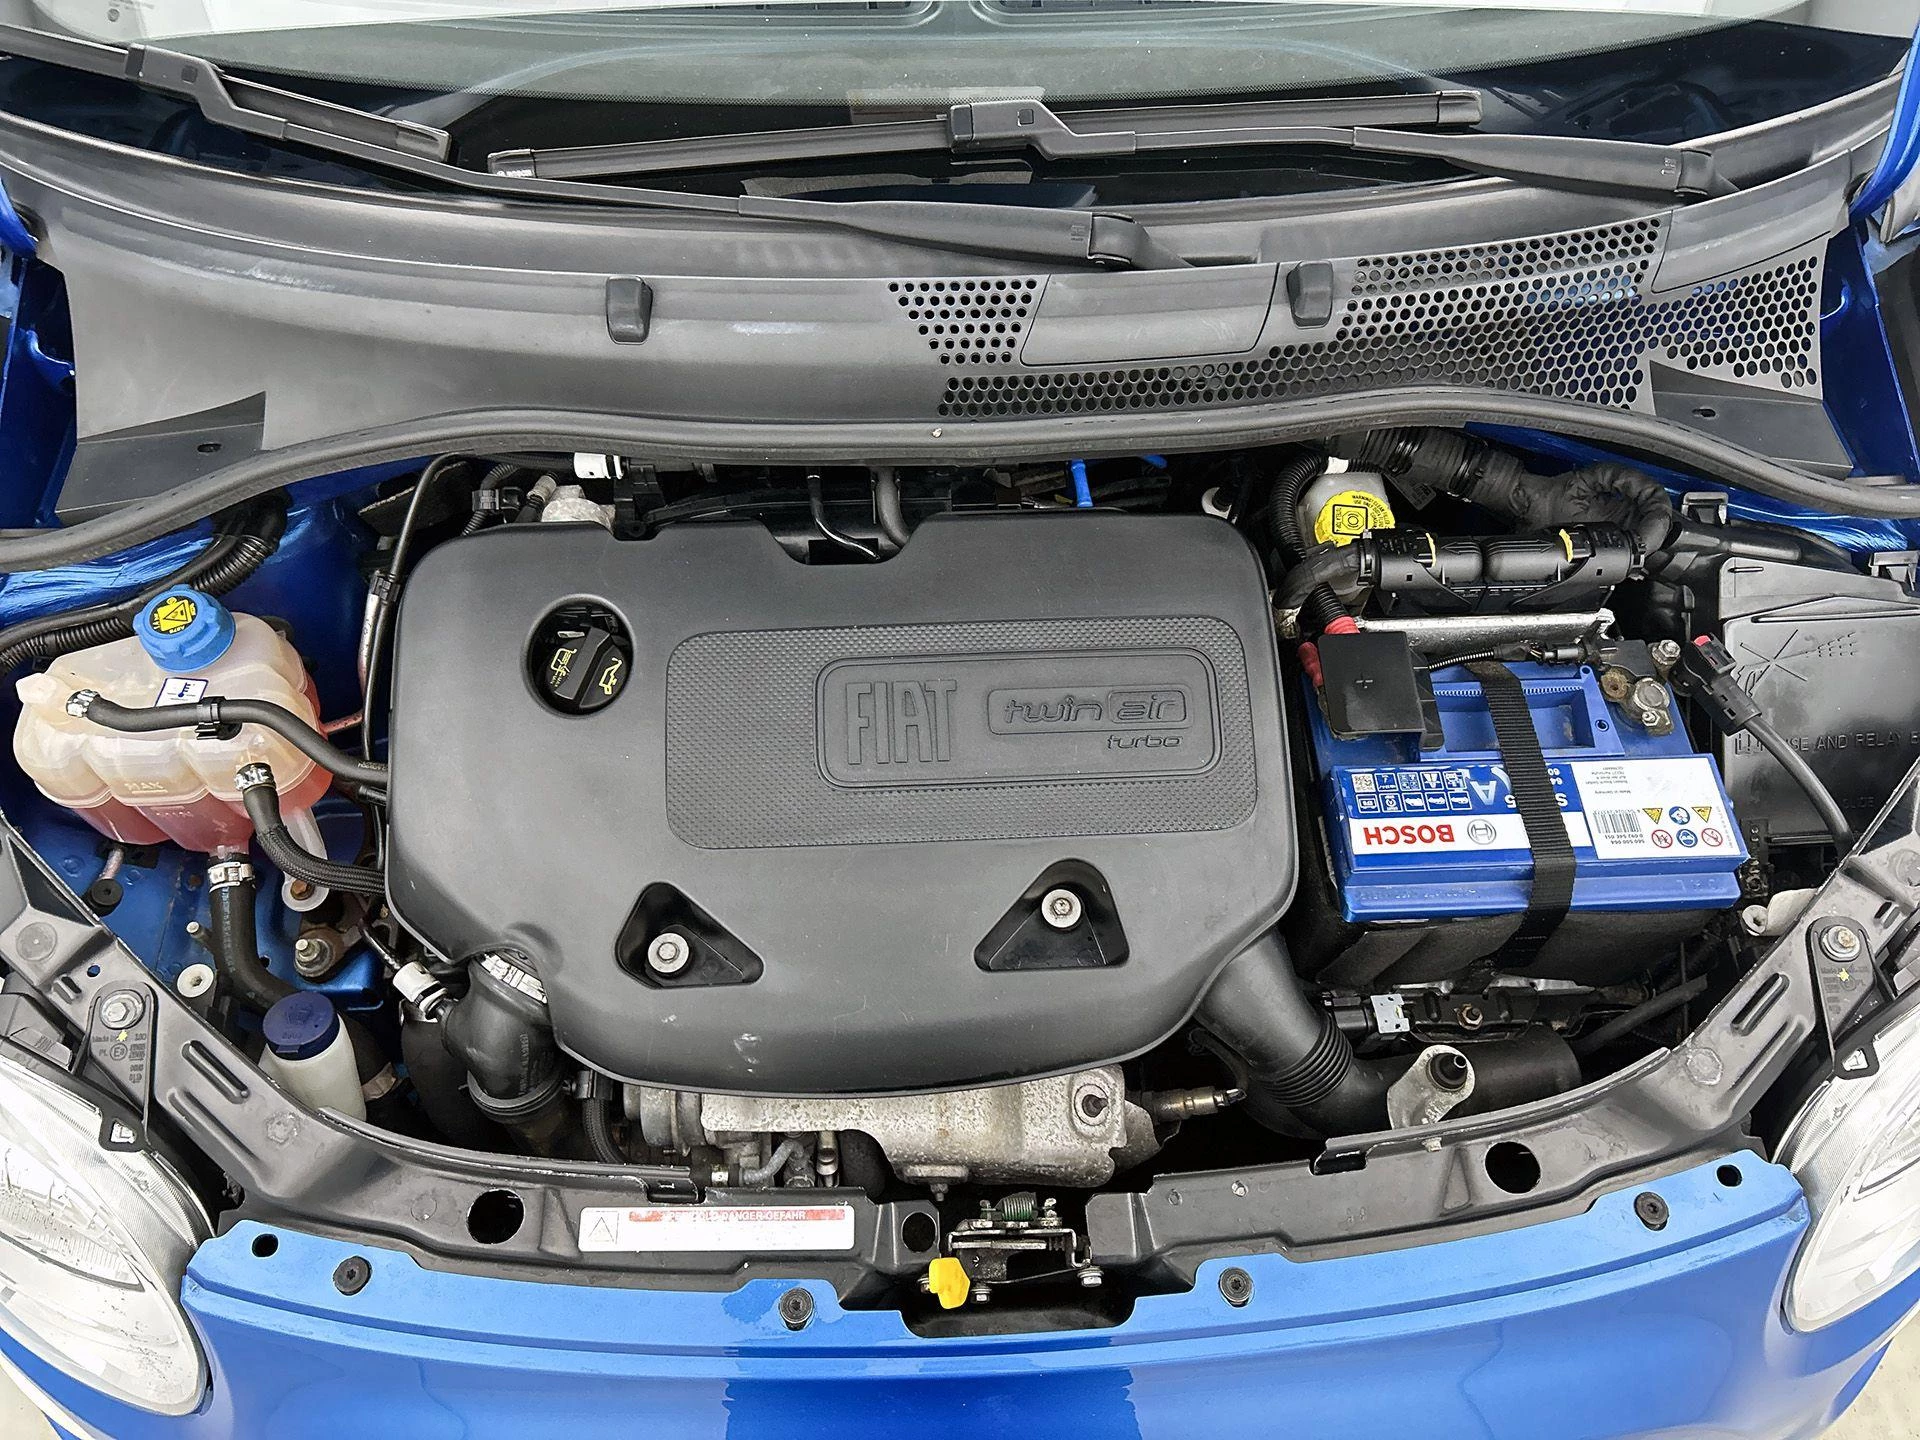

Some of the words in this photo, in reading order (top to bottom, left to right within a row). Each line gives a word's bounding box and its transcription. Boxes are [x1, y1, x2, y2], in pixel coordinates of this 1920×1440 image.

[844, 679, 957, 766] FIAT
[1106, 733, 1183, 750] turbo
[1816, 734, 1849, 750] AND
[1855, 731, 1902, 748] RELAY
[1362, 824, 1455, 846] BOSCH
